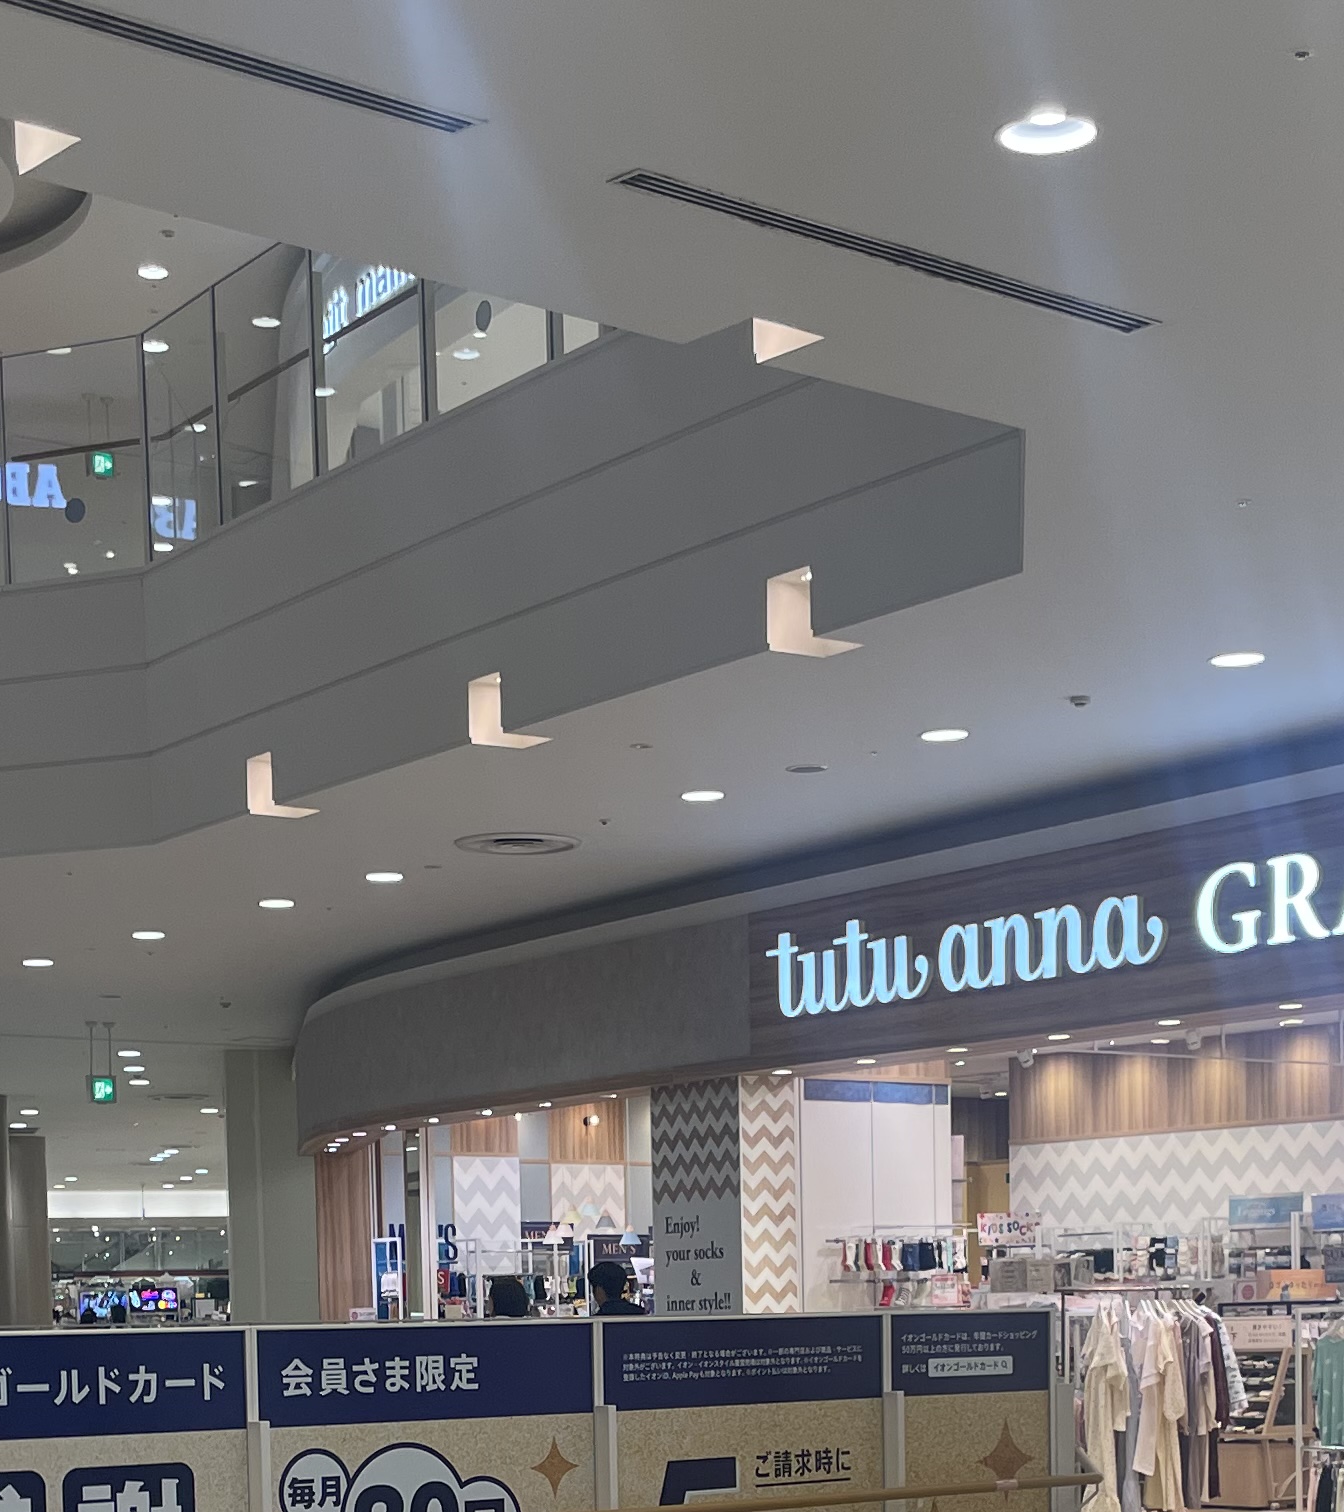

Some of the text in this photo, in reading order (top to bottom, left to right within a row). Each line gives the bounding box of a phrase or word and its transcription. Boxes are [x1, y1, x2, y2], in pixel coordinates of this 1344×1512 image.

[765, 917, 928, 1019] tutu
[938, 892, 1166, 993] anna
[665, 1214, 700, 1239] Enjoy!
[388, 1223, 458, 1261] M'S
[601, 1243, 637, 1255] MENS
[665, 1240, 725, 1268] your socks
[690, 1269, 702, 1286] &
[666, 1292, 732, 1315] inner style!!
[280, 1353, 479, 1397] 会員さま限定
[933, 1360, 999, 1373] イオンゴールドカード
[755, 1447, 851, 1479] ご請求時に
[287, 1475, 342, 1510] 毎月
